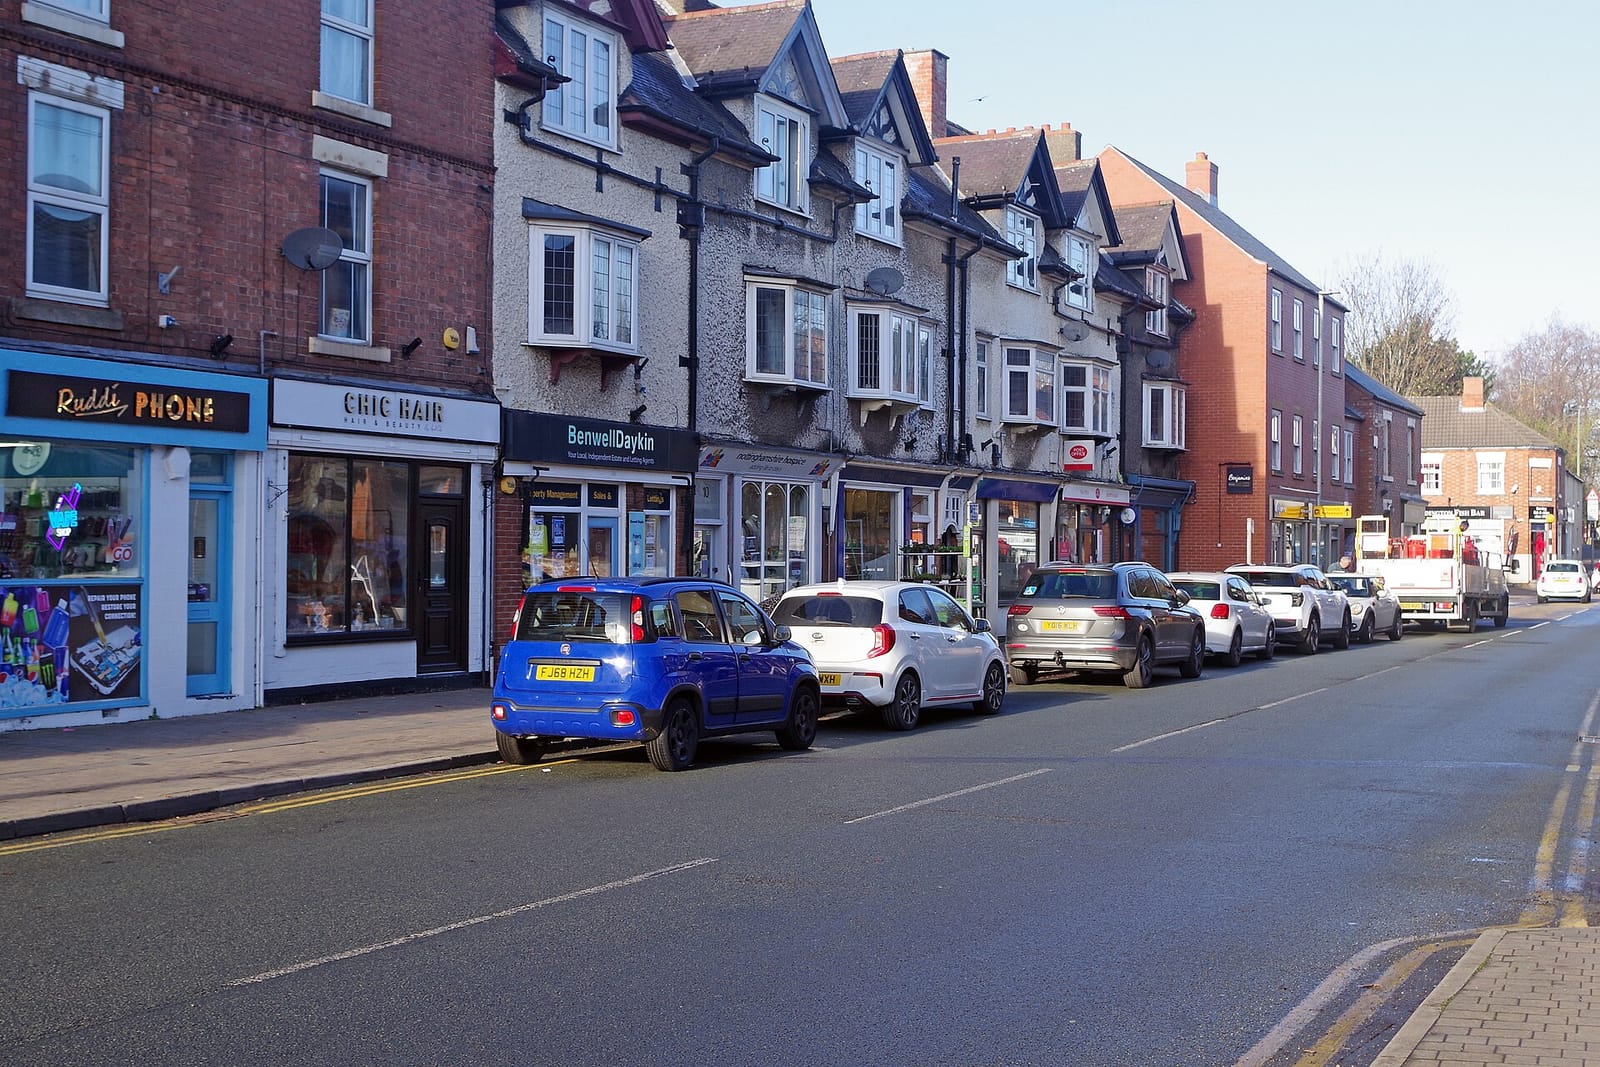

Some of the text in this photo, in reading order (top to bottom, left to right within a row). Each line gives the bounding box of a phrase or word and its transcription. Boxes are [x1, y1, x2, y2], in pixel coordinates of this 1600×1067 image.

[134, 391, 214, 422] PHONE
[344, 391, 443, 423] CHIC HAIR
[344, 417, 367, 425] HAIR
[568, 425, 655, 454] BenwellDaykin
[784, 455, 806, 466] hospice
[546, 489, 578, 500] Management
[593, 490, 606, 500] Sales
[106, 594, 120, 602] YOUR
[119, 593, 137, 601] PHONE
[540, 667, 589, 679] FJ68 HZH
